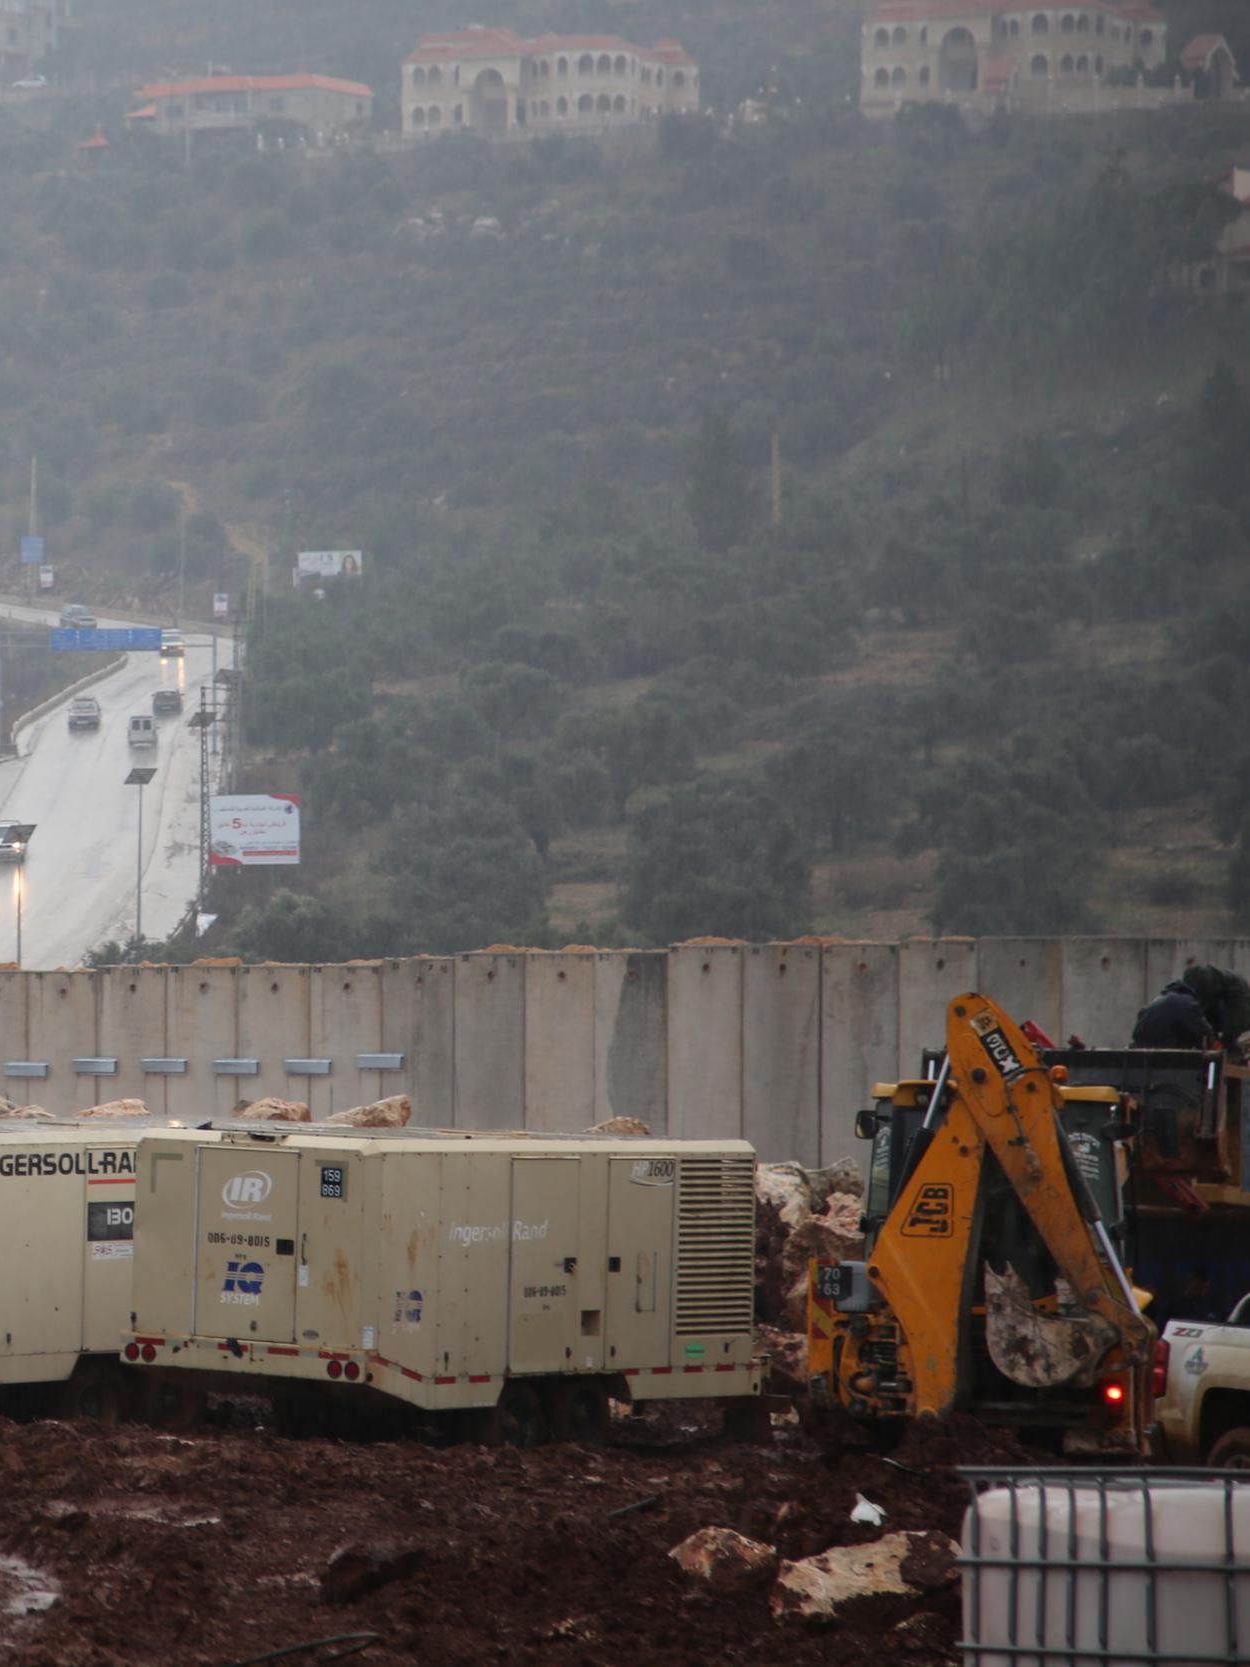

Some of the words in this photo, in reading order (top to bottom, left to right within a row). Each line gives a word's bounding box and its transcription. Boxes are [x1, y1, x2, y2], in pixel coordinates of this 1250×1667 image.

[232, 817, 242, 829] 5
[323, 1169, 341, 1182] 159
[229, 1176, 264, 1202] IR
[909, 1187, 949, 1232] JCB
[220, 1293, 260, 1306] SYSTEM
